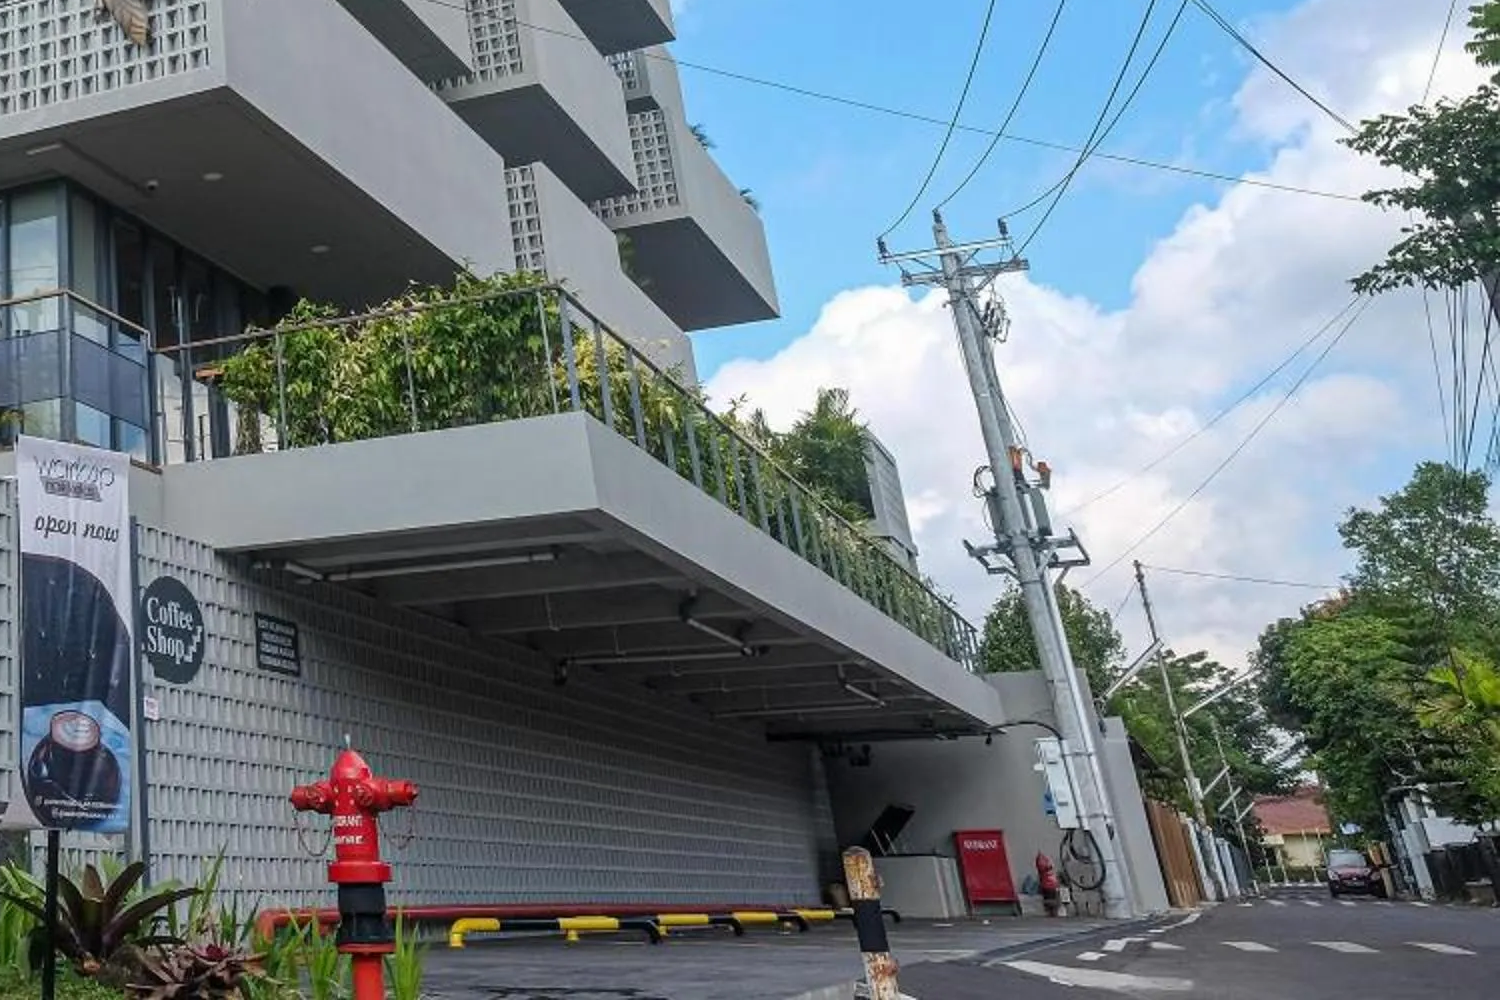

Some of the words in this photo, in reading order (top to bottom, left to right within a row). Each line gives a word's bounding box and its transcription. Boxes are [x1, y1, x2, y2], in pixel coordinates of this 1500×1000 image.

[34, 516, 77, 539] open
[82, 523, 119, 542] now
[147, 596, 194, 631] Coffee
[147, 625, 185, 665] Shop
